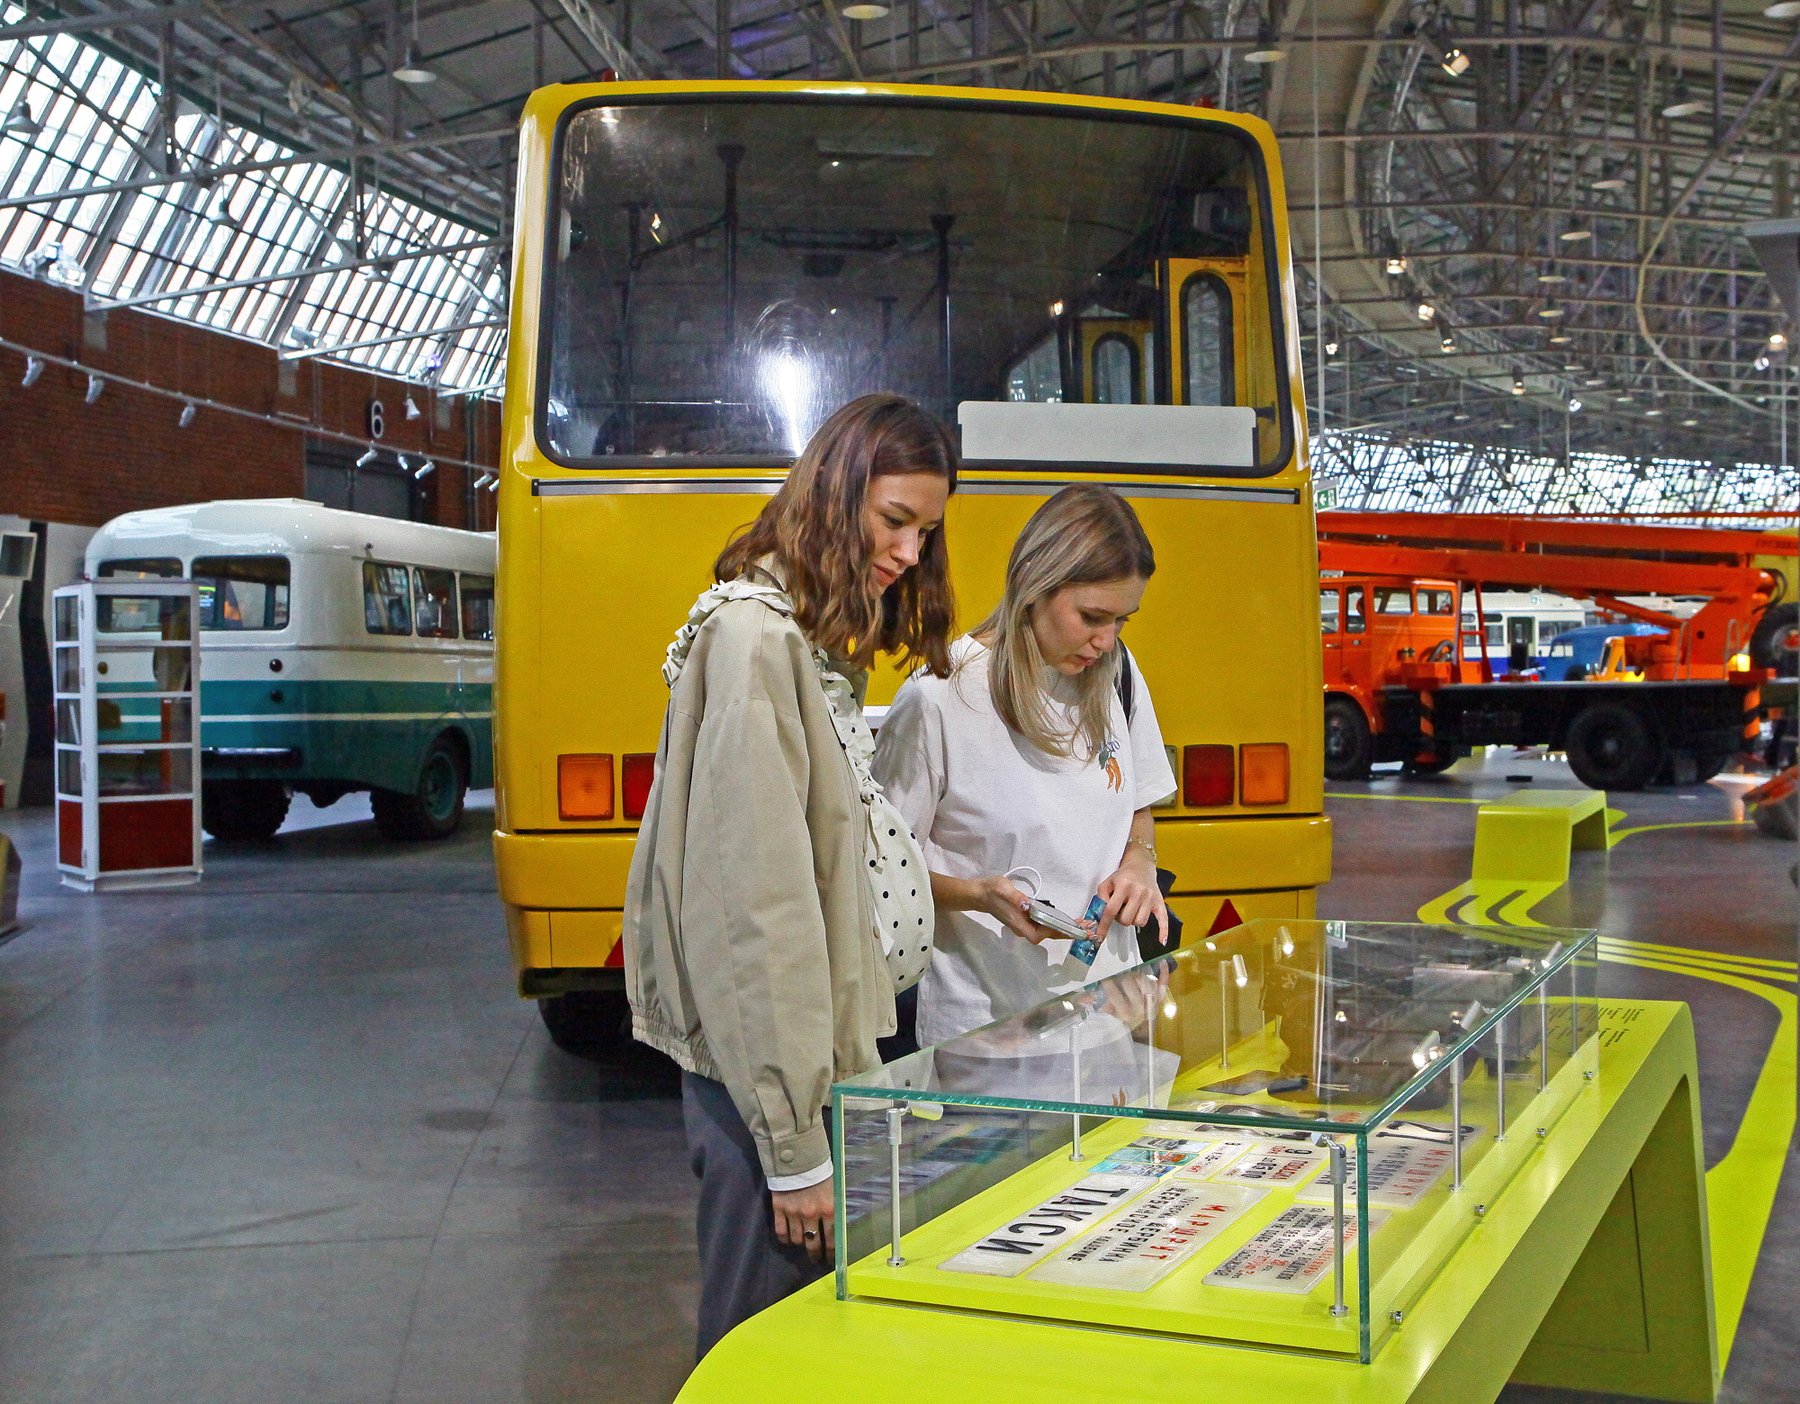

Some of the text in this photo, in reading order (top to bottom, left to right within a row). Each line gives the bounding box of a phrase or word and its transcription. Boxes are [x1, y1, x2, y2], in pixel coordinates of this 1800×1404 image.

[371, 400, 385, 439] 6
[1386, 1149, 1453, 1196] МАРШРУТ
[976, 1187, 1130, 1255] ТАКСИ
[1139, 1204, 1229, 1260] МАРШРУТ
